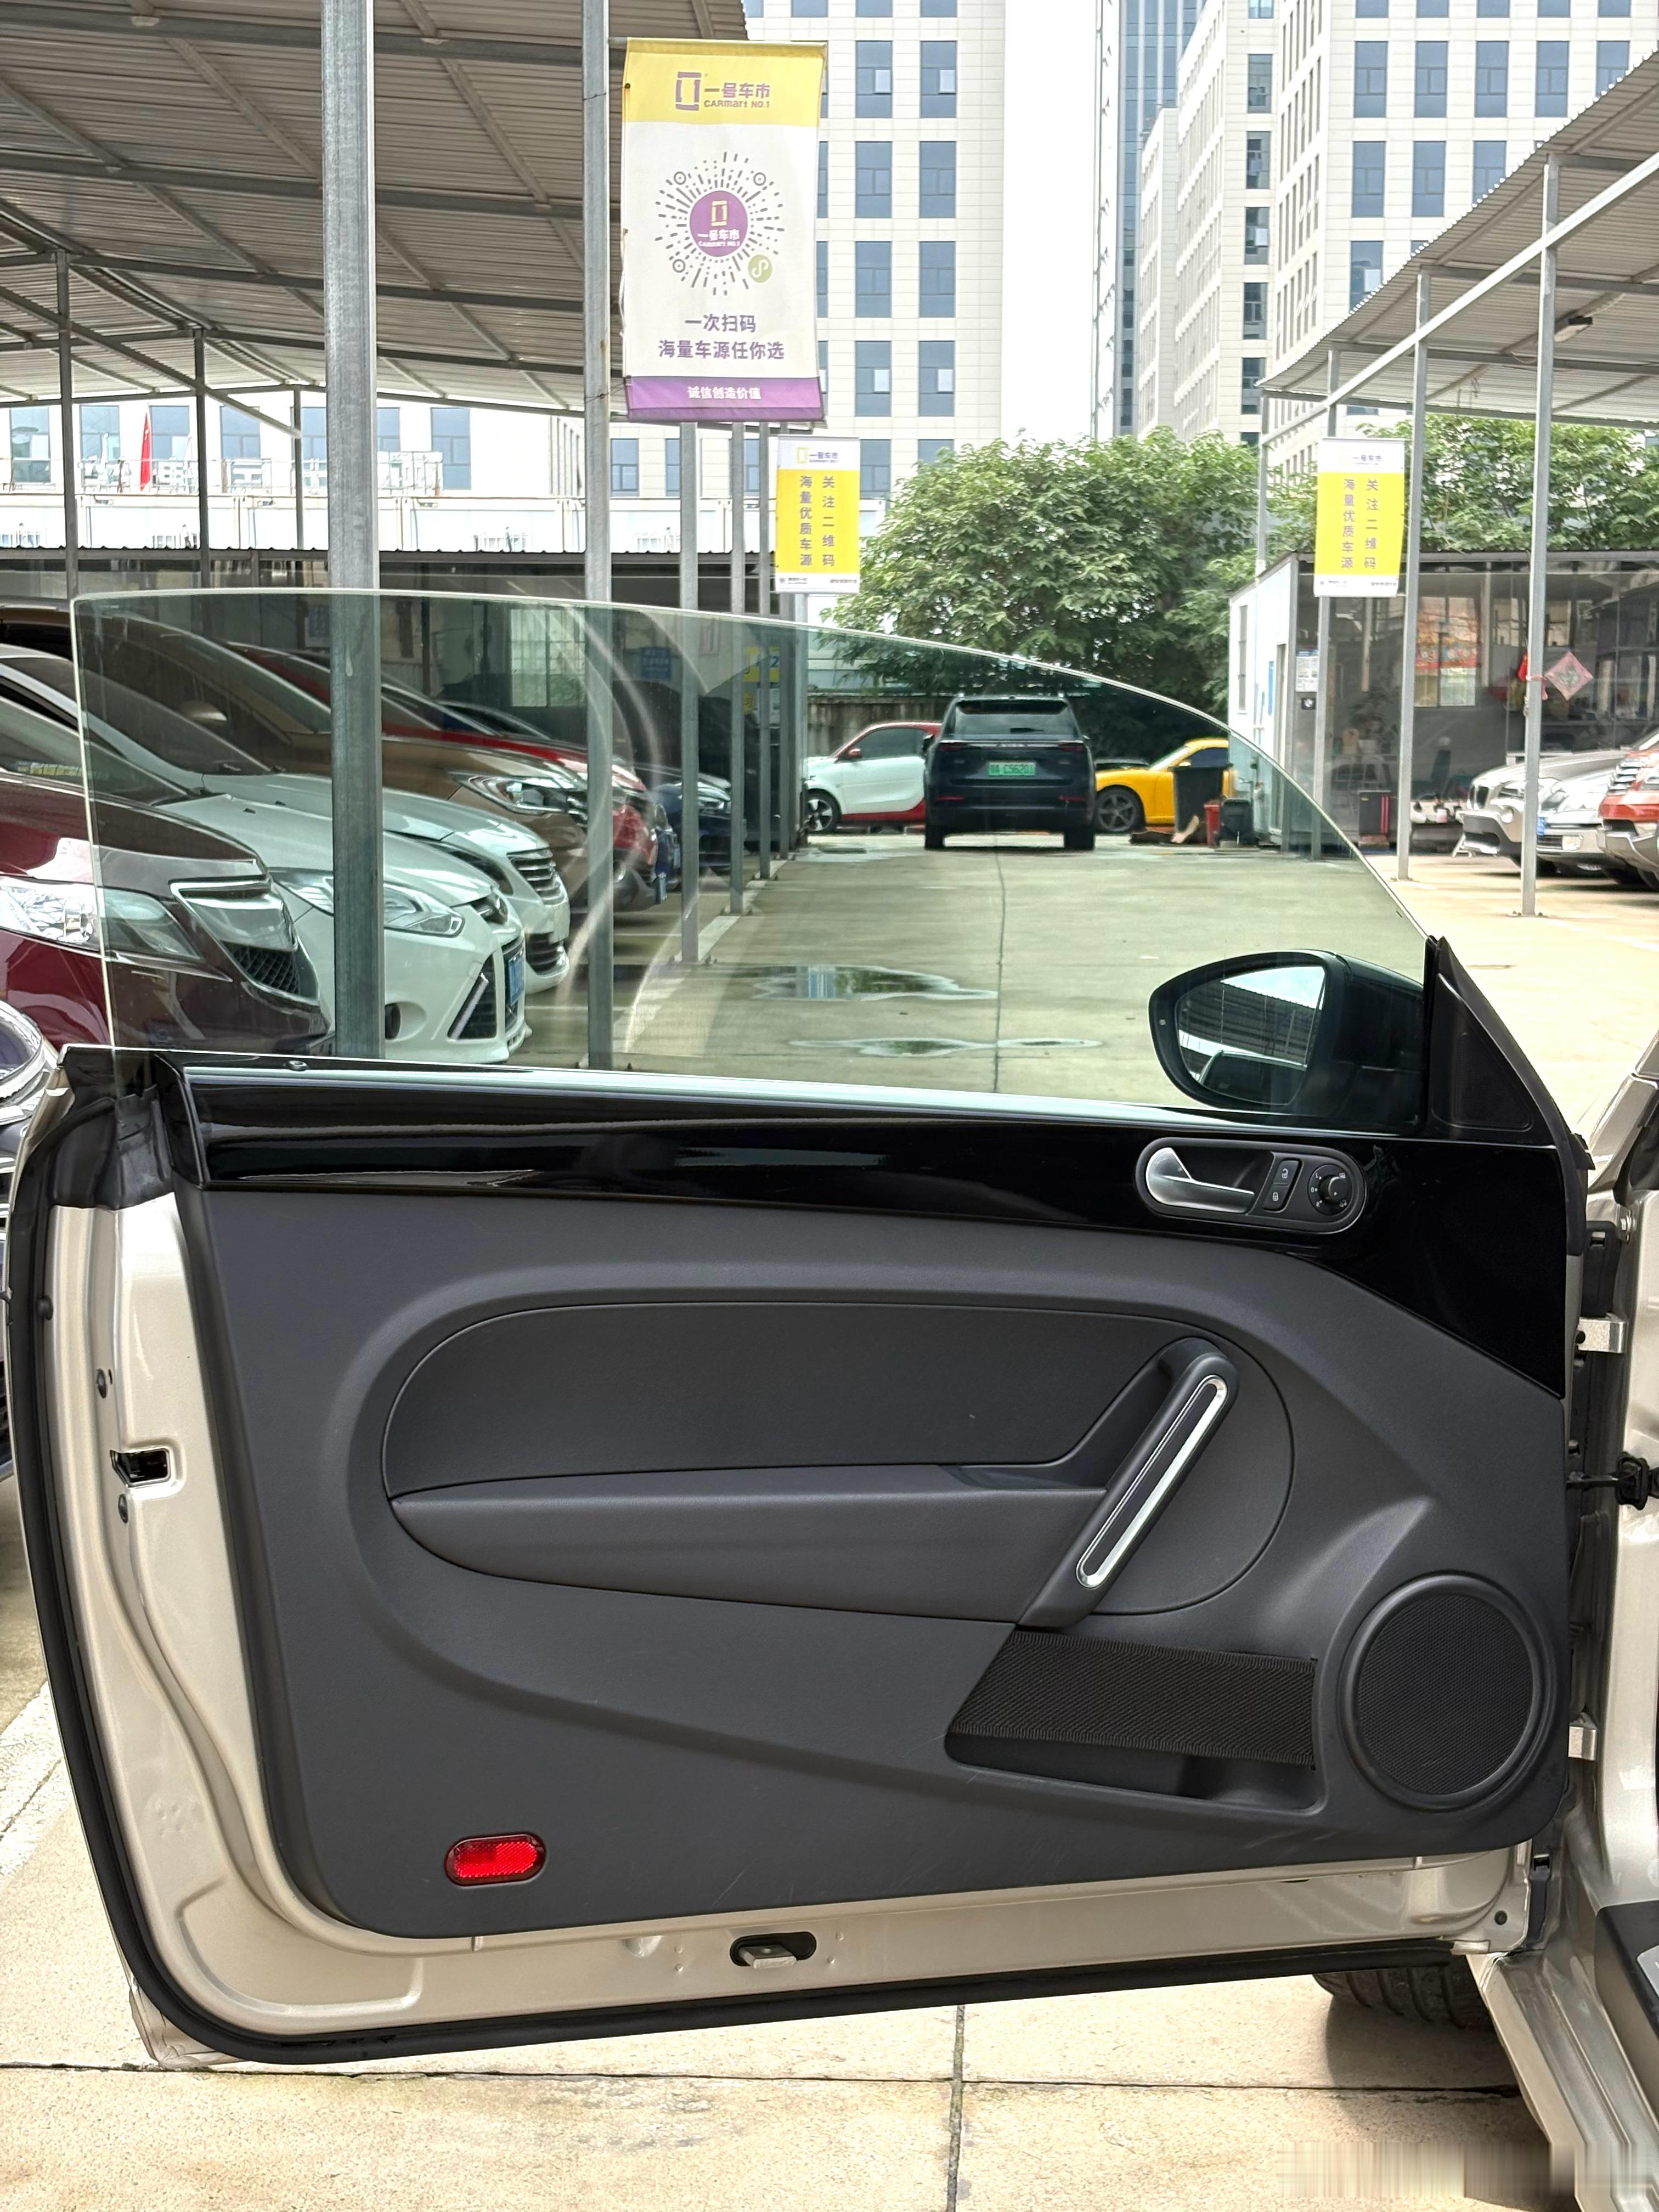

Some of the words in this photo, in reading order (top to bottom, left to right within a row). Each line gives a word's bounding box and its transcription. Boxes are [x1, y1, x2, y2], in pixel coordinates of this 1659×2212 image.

[704, 82, 770, 99] 一号车市
[658, 340, 785, 360] 海量车源任你选
[685, 314, 757, 332] 一次扫码
[687, 386, 761, 400] 诚信创造价值
[799, 475, 812, 567] 海量优质车源
[822, 476, 835, 567] 关注二维码
[1341, 478, 1356, 569] 海量优质车源
[1364, 478, 1379, 569] 关注二维码
